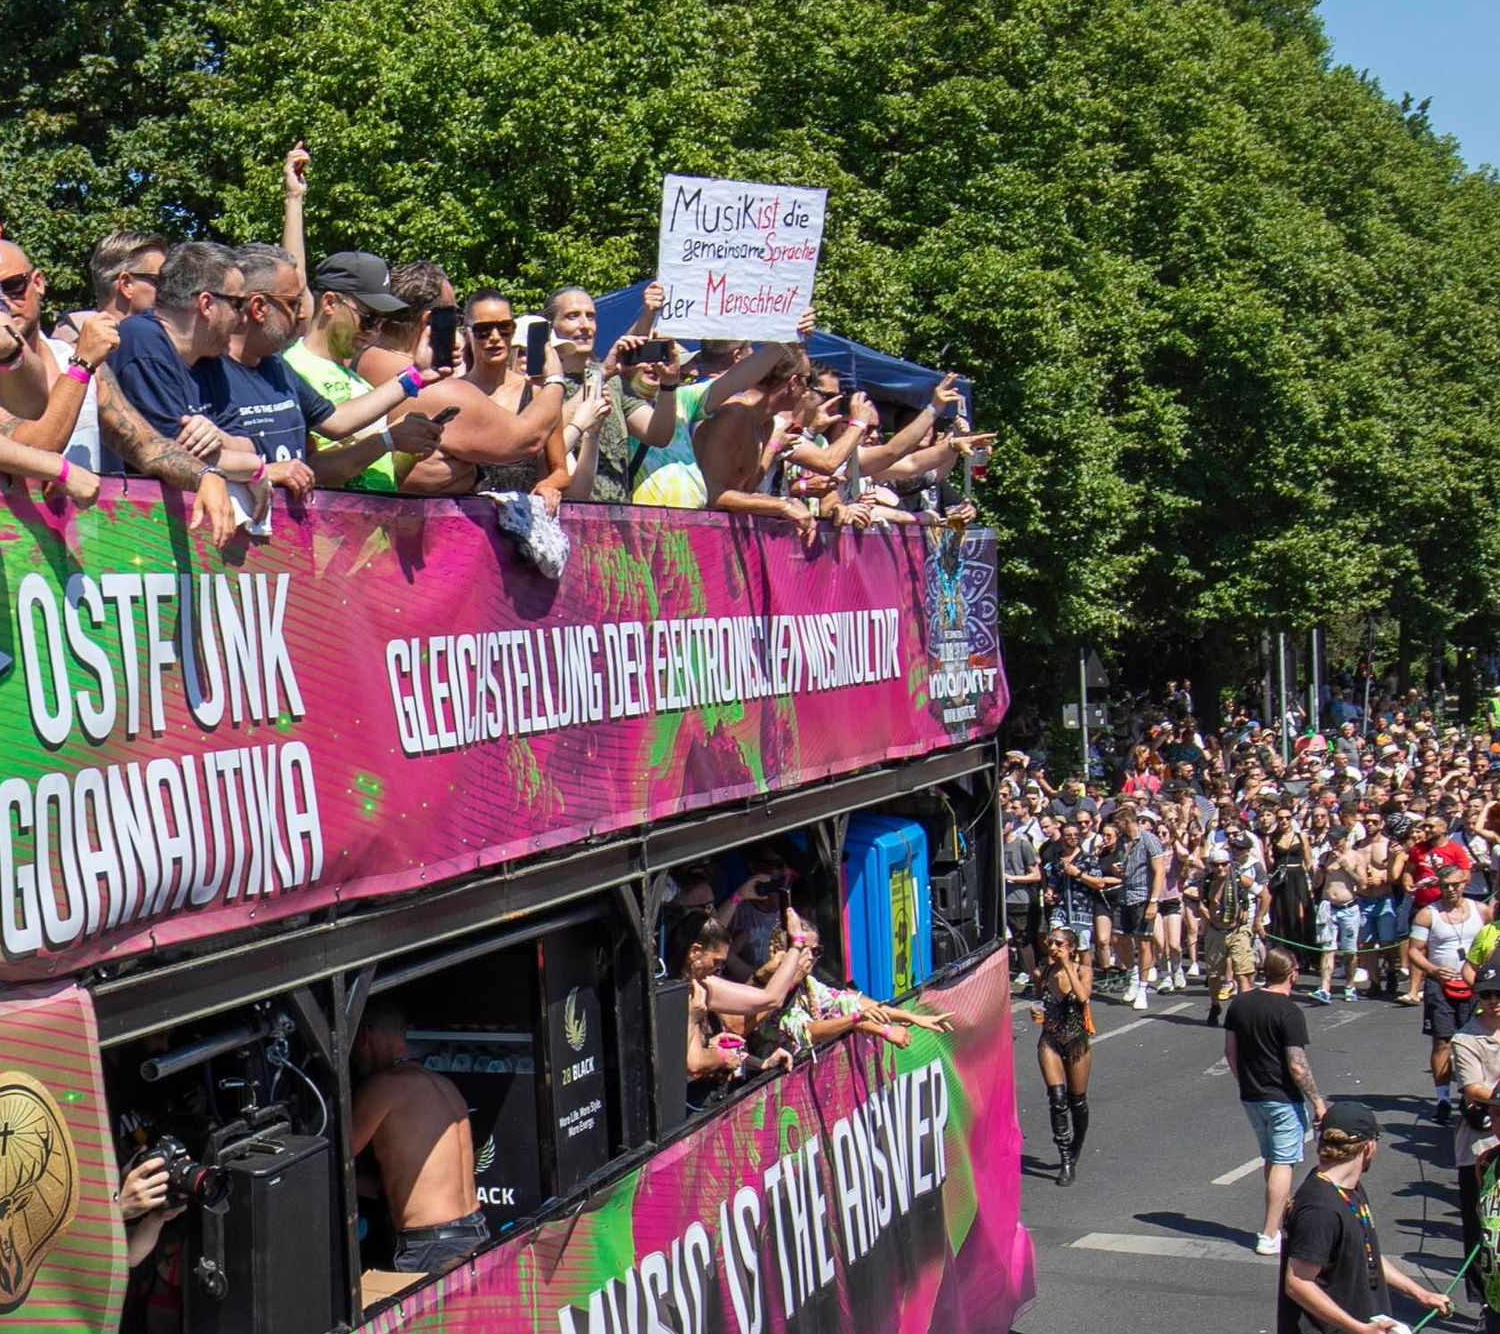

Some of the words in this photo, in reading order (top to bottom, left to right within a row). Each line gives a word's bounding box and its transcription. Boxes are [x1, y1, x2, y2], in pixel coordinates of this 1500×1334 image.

[757, 197, 780, 230] ist
[783, 199, 810, 228] die
[682, 238, 765, 262] gemeinsame
[763, 231, 817, 268] Sprache
[661, 284, 696, 320] der
[704, 269, 799, 316] Menschheit
[17, 572, 306, 745] OSTFUNK
[386, 623, 603, 754] GLEICHSTELLUNG
[602, 620, 651, 719] DER
[572, 1055, 596, 1081] BLACK
[477, 1186, 515, 1205] ACK
[764, 1133, 836, 1320] THE
[832, 1057, 950, 1267] ANSWER
